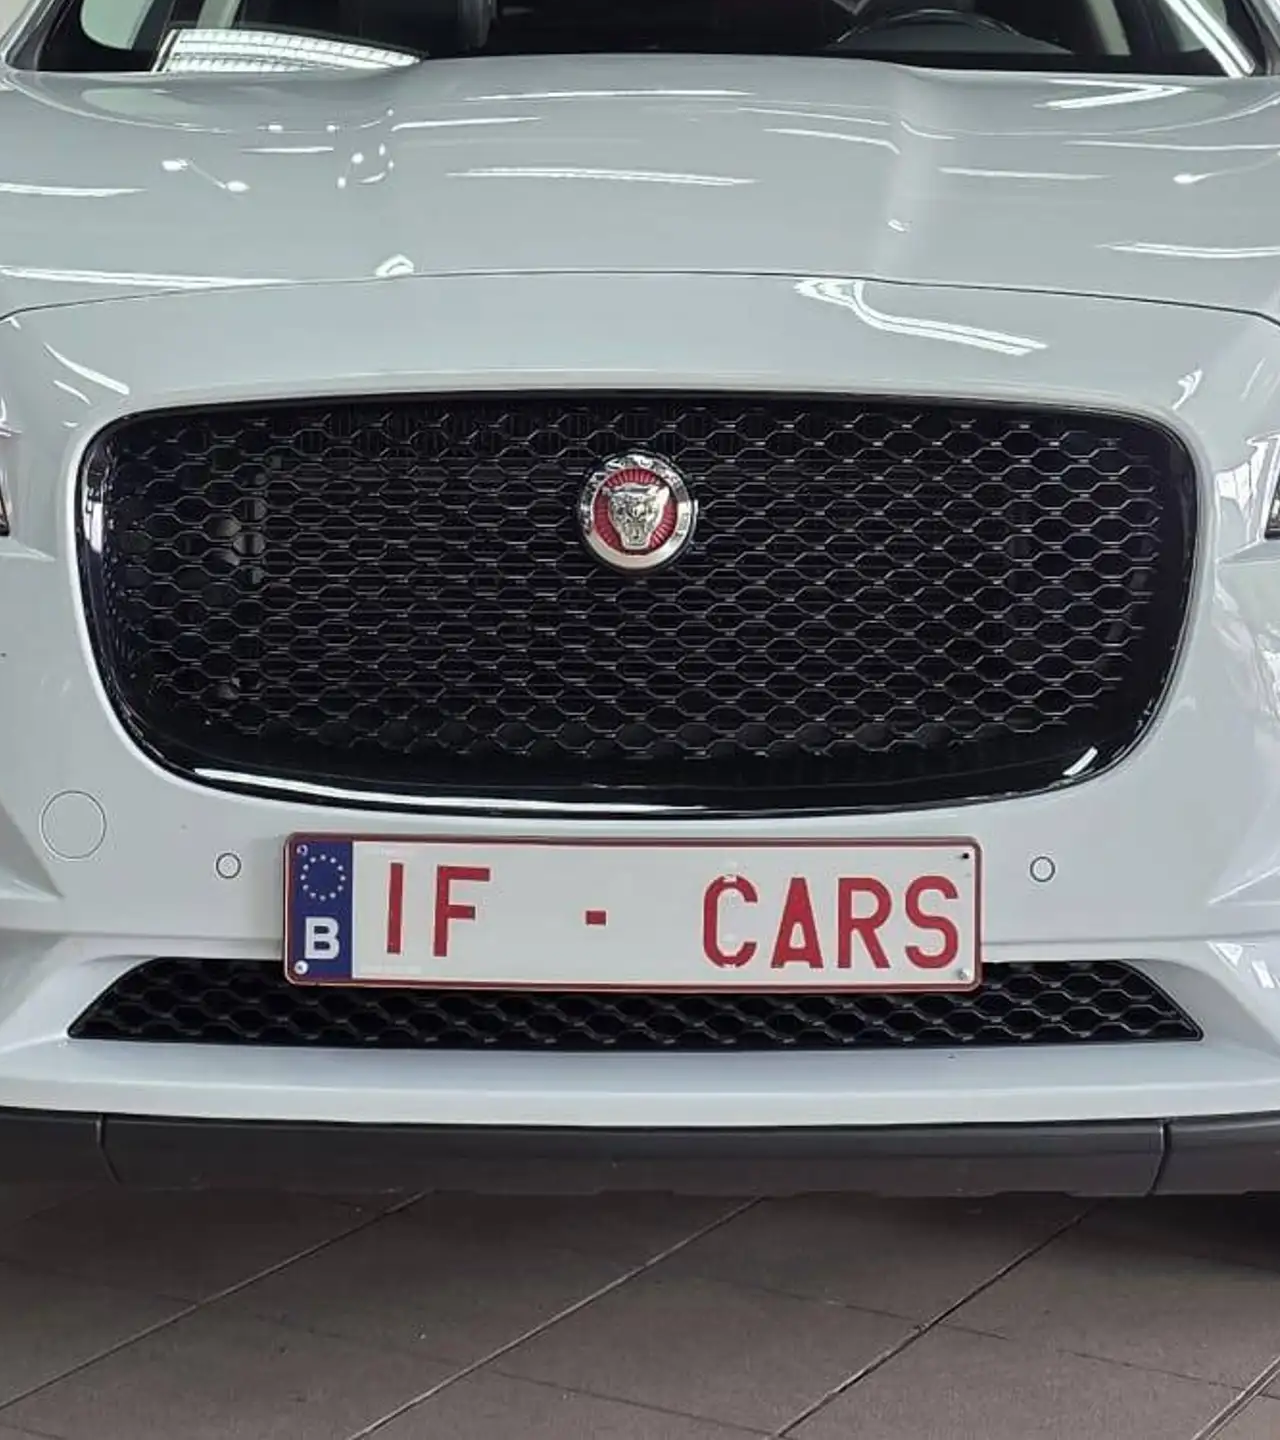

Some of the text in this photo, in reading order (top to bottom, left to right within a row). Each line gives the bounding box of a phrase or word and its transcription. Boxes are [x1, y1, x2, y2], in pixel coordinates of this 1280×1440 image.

[304, 917, 341, 960] B
[387, 863, 490, 957] IF
[702, 874, 959, 970] CARS
